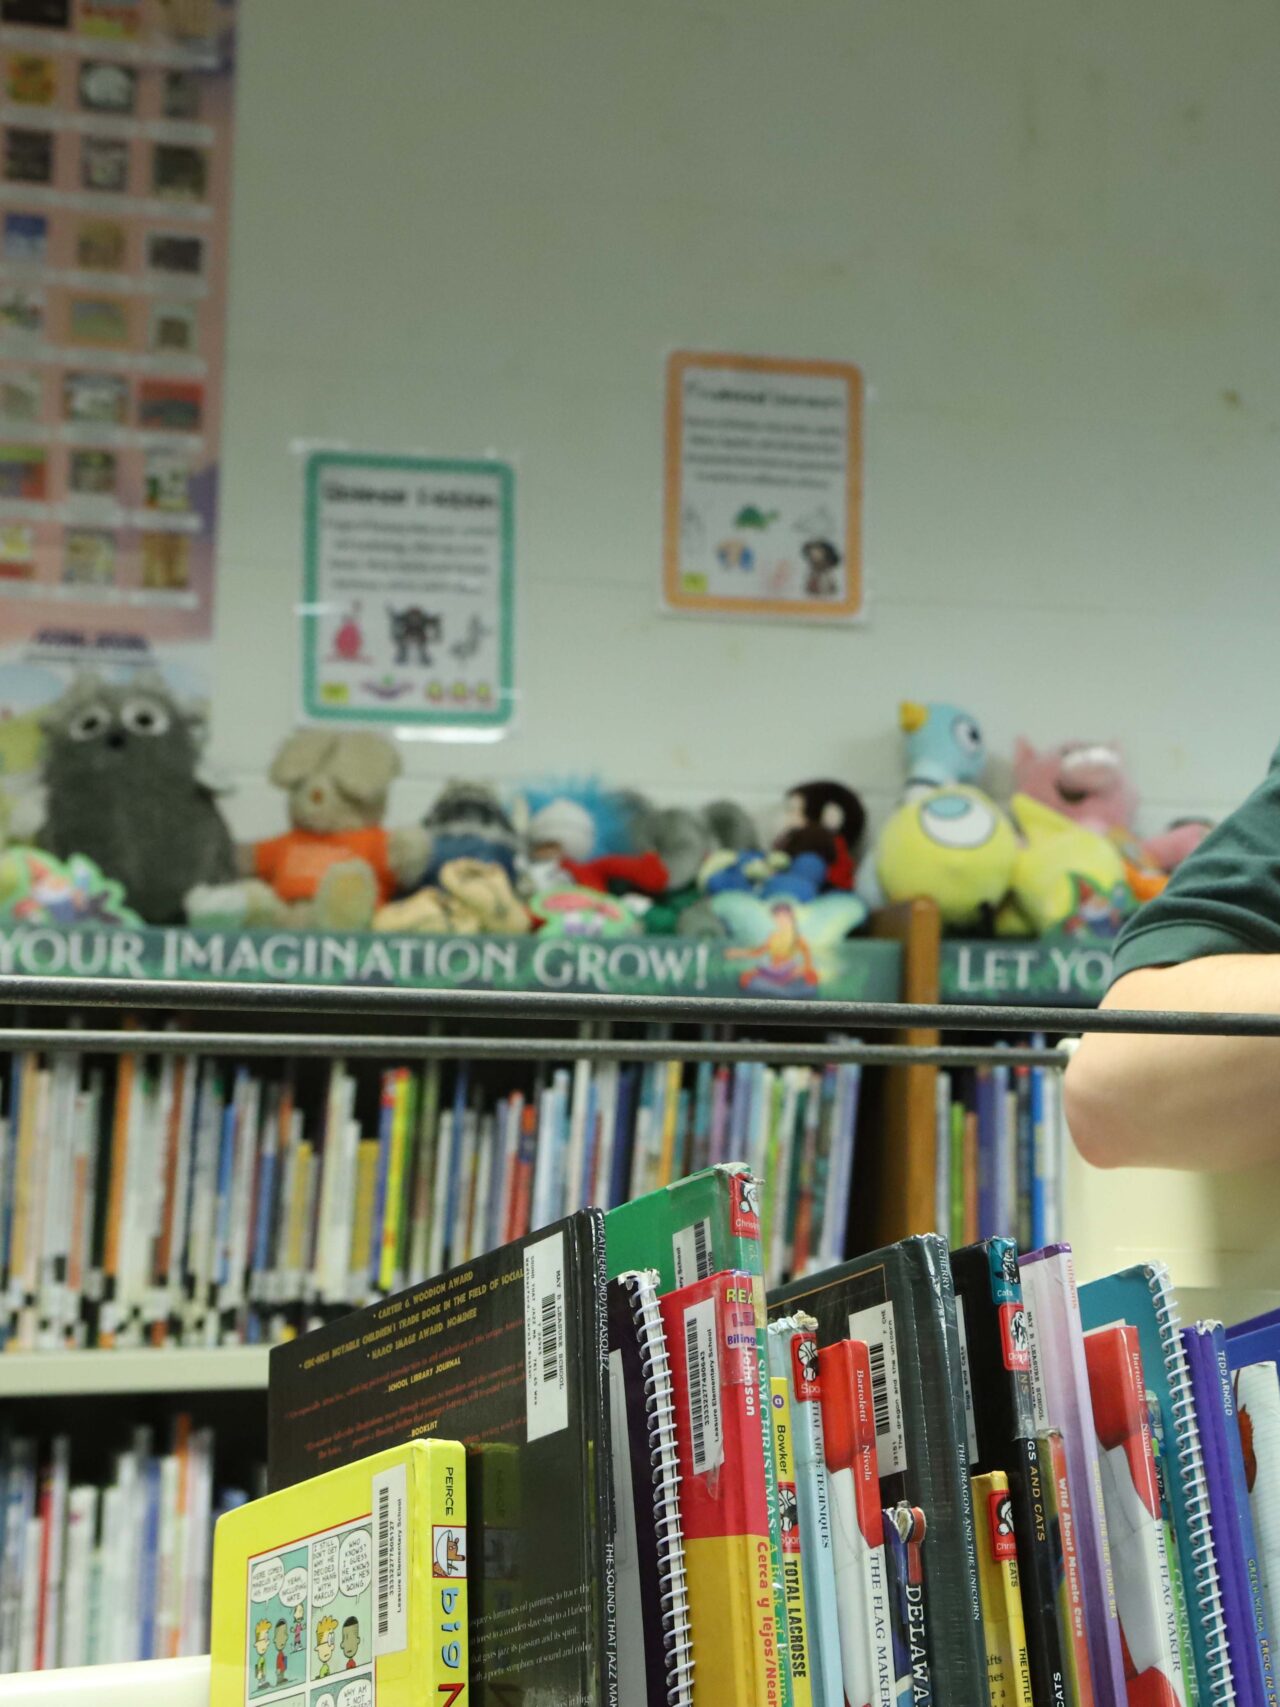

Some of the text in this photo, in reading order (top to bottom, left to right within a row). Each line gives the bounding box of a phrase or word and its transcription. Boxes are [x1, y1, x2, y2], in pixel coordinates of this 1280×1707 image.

[0, 927, 708, 992] YOUR IMAGINATION GROW!
[957, 946, 1039, 991] LET
[447, 1270, 474, 1291] AWARD
[596, 1217, 610, 1371] WEATHERFORD/VELASQUEZ
[937, 1248, 950, 1290] CHERRY
[398, 1312, 420, 1330] TRADE
[421, 1303, 442, 1320] BOOK
[453, 1292, 467, 1307] THE
[468, 1284, 487, 1301] FIELD
[418, 1321, 444, 1341] AWARD
[446, 1307, 478, 1329] NOMINEE
[409, 1356, 462, 1385] LIBRARY JOURNAL
[556, 1305, 566, 1391] LEASURE SCHOOL
[709, 1359, 718, 1408] Elementary
[741, 1347, 756, 1417] Johnson
[889, 1319, 903, 1431] dragon unicorn
[1030, 1343, 1045, 1421] LEASURE SCHOOL
[1217, 1350, 1233, 1417] TEDD ARNOLD
[856, 1369, 873, 1481] Bartoletti Nivola
[1131, 1352, 1151, 1458] Bartoletti Nivola
[776, 1424, 788, 1475] Bowker
[444, 1465, 455, 1517] PEIRCE
[816, 1472, 829, 1549] TECHNIQUES
[1026, 1440, 1046, 1543] GS AND CATS
[319, 1539, 335, 1550] STILL
[605, 1542, 614, 1565] THE
[958, 1443, 981, 1622] THE DRAGON AND THE UNICORN
[313, 1564, 335, 1577] DECIDED
[321, 1572, 337, 1582] HANG
[341, 1573, 357, 1584] WHAT
[349, 1553, 368, 1565] GUESS
[352, 1560, 370, 1573] KNOWS
[757, 1541, 769, 1590] Cerca
[1009, 1557, 1019, 1588] EATS
[1058, 1478, 1084, 1638] Wild About Muscle Cars
[1105, 1568, 1116, 1598] DARK
[605, 1568, 616, 1614] SOUND
[757, 1597, 770, 1609] y
[1108, 1599, 1118, 1619] SEA
[440, 1586, 462, 1670] big
[607, 1618, 616, 1649] THAT
[784, 1559, 807, 1679] TOTAL LACROSSE
[869, 1555, 892, 1707] THE FLAG MAKER
[1160, 1559, 1172, 1606] FLAG
[1166, 1610, 1181, 1674] MAKER
[1248, 1558, 1276, 1690] GREEN FROG IN
[606, 1651, 617, 1680] JAZZ
[906, 1584, 931, 1707] DELAWA
[1018, 1646, 1032, 1704] THE LITTLE
